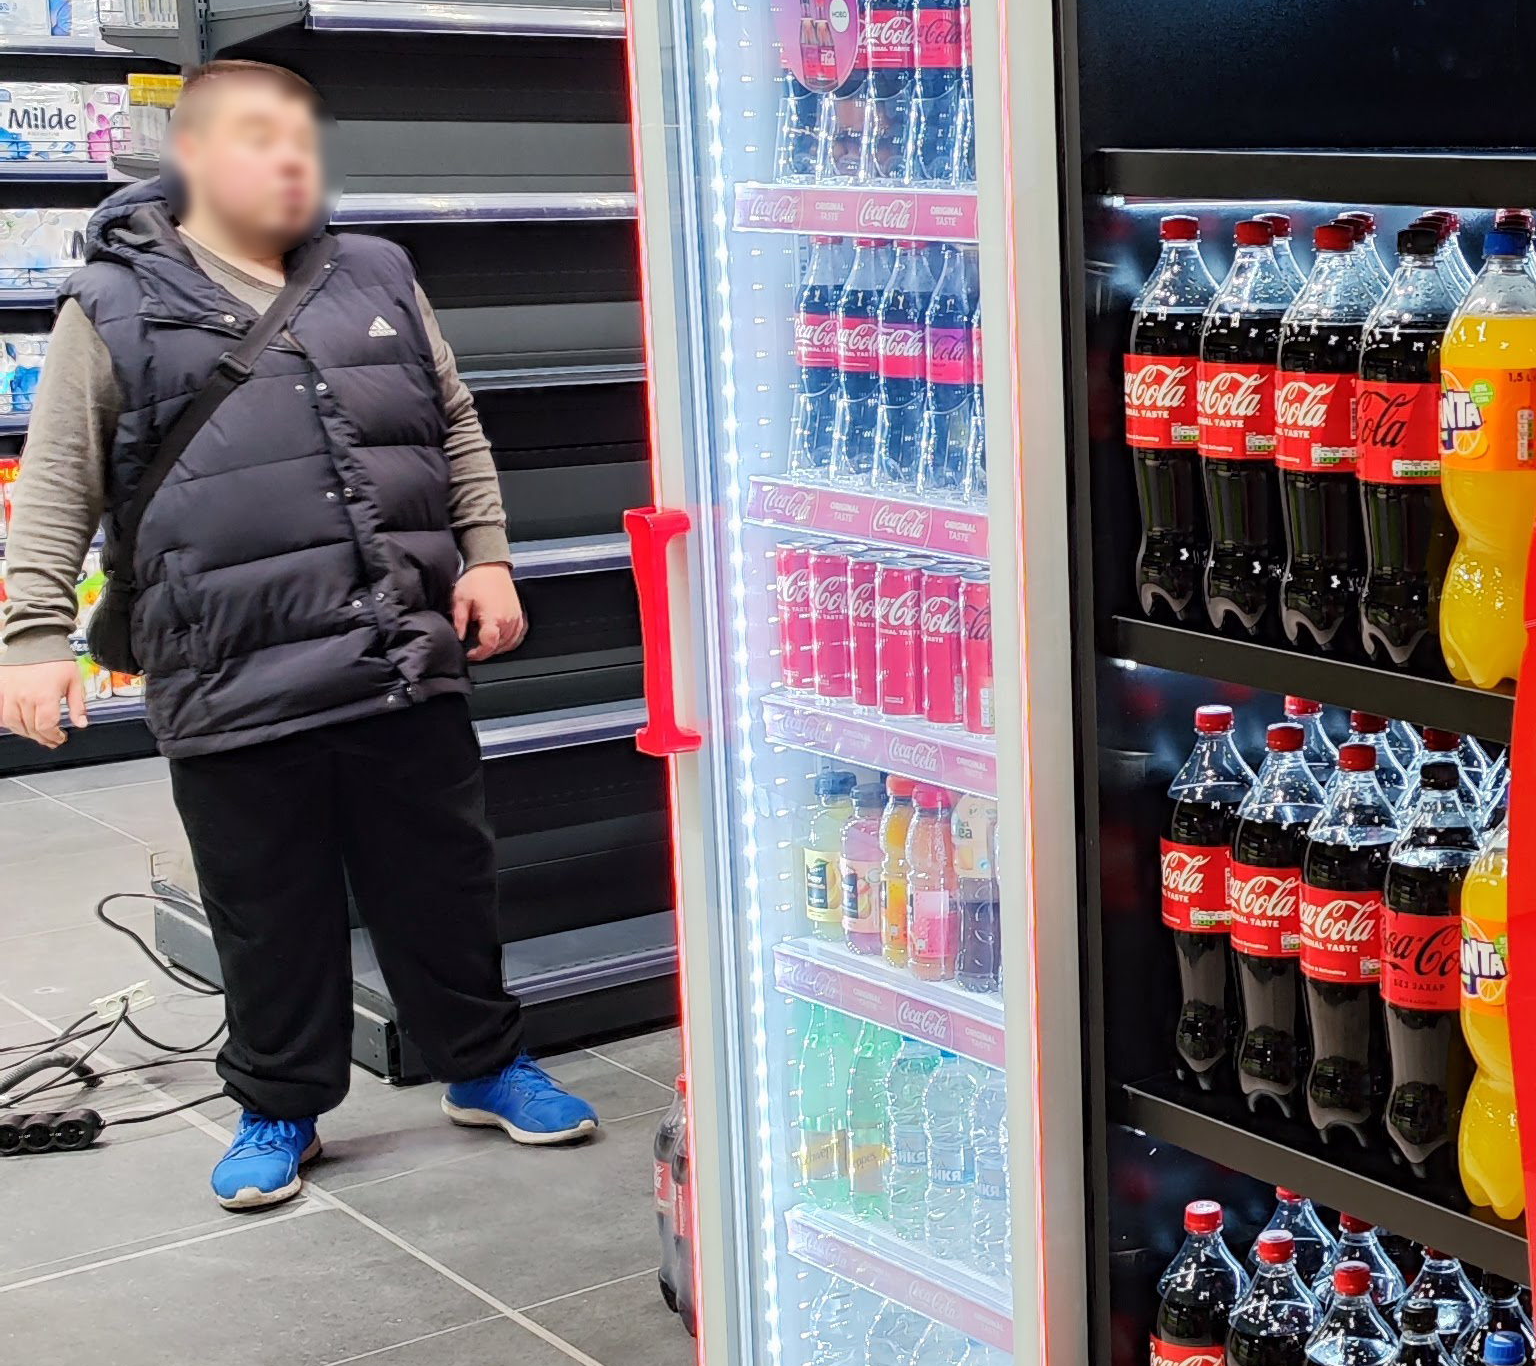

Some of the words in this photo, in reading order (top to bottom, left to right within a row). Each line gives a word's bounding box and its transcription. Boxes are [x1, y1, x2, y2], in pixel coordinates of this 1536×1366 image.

[8, 107, 77, 131] Milde
[859, 197, 913, 229] Coca-Cola
[930, 205, 963, 217] ORIGINAL
[935, 215, 957, 227] TASTE
[1141, 410, 1169, 420] TASTE
[1214, 418, 1244, 429] TASTE
[1283, 428, 1310, 439] TASTE
[872, 505, 928, 540] Coca-Cola
[944, 519, 977, 534] ORIGINAL
[949, 530, 970, 543] TASTE
[889, 737, 939, 772] Coca-Cola
[1166, 891, 1190, 903] TASTE
[1249, 919, 1280, 928] TASTE
[1328, 943, 1358, 953] TASTE
[897, 1002, 948, 1040] Coca-Cola
